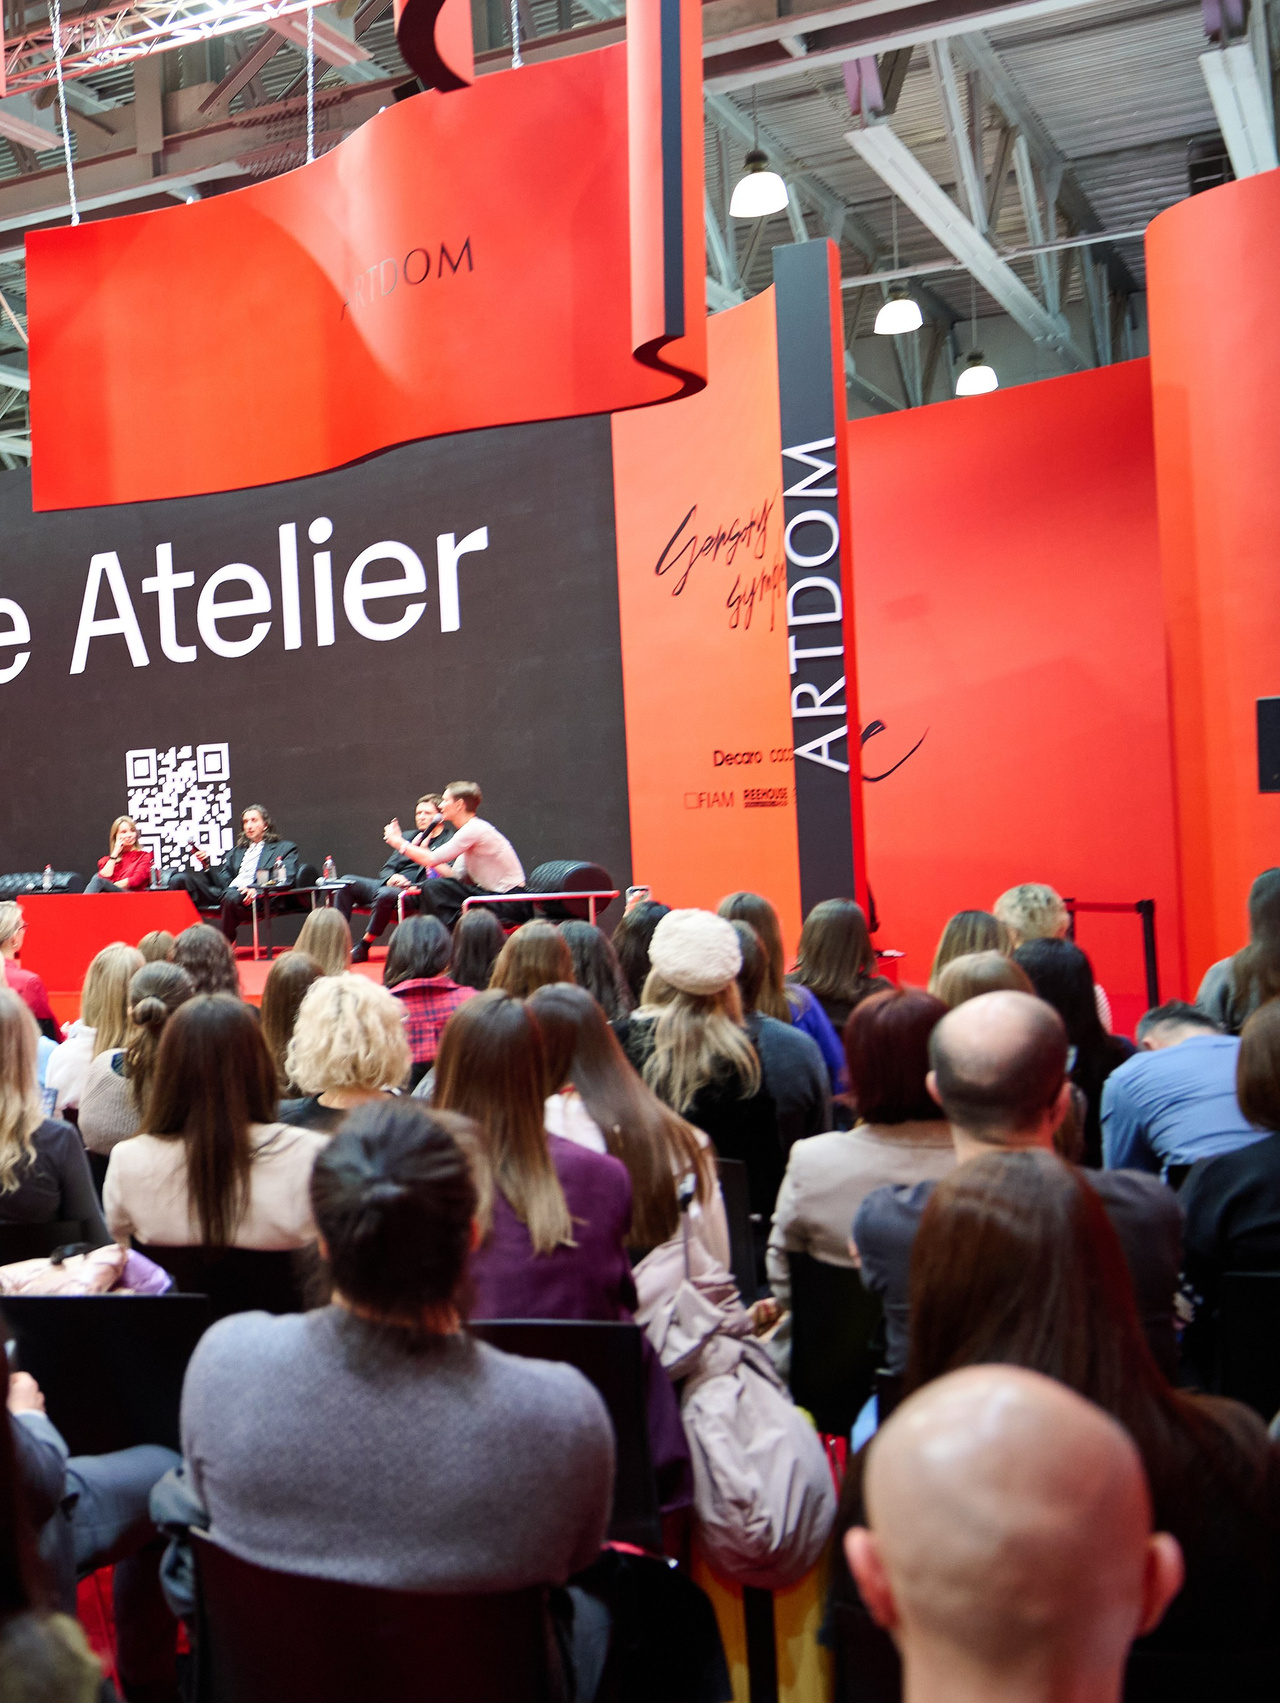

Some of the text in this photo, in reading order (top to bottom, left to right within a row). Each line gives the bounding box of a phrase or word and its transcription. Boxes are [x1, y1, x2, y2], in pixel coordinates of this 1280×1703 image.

[69, 516, 489, 675] Atelier
[780, 436, 850, 774] ARTDOM
[697, 789, 736, 810] FIAM
